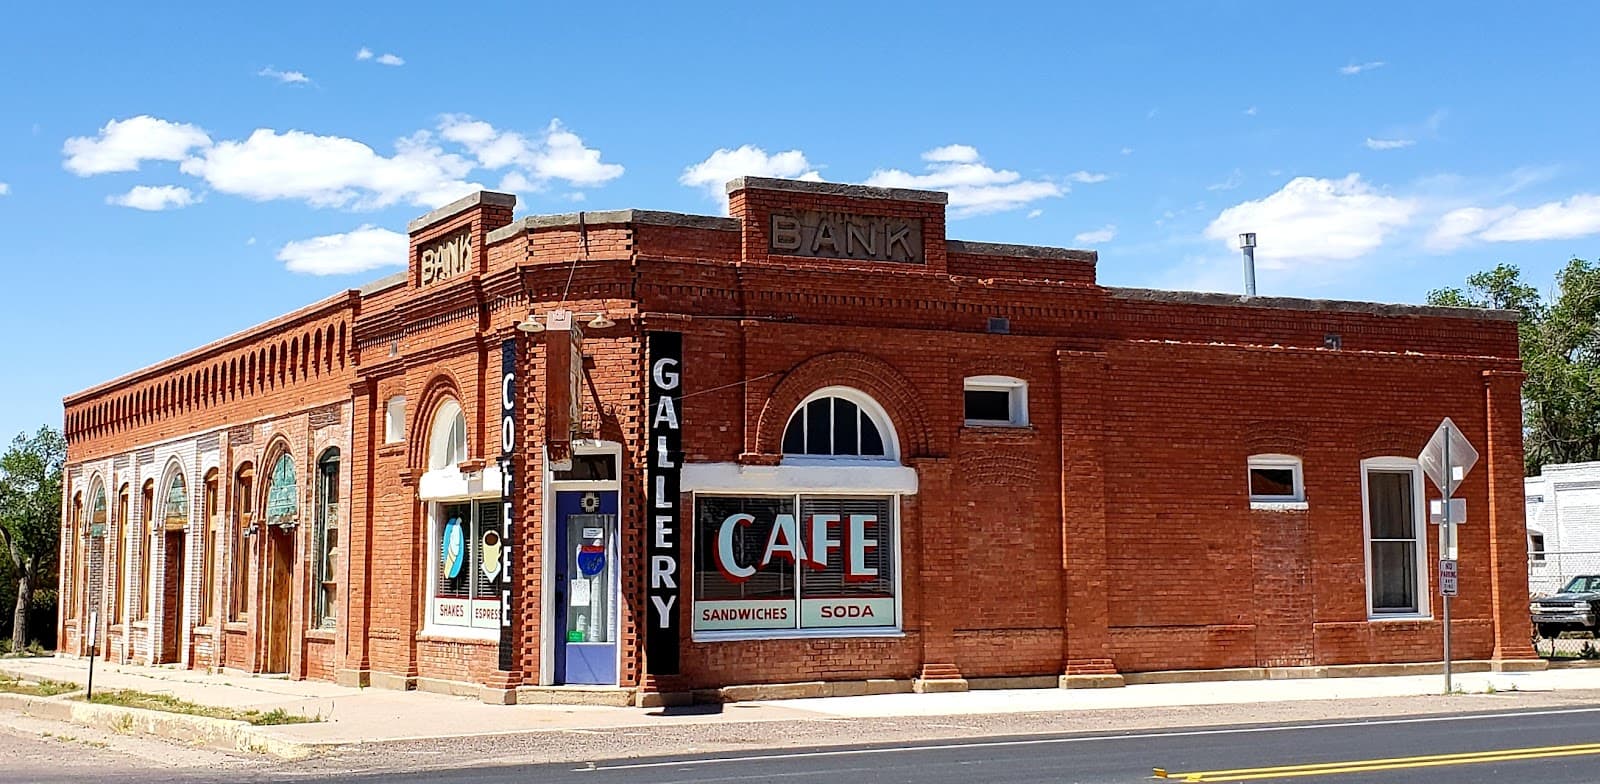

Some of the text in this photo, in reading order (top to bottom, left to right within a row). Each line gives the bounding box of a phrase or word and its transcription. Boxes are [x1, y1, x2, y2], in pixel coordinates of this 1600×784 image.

[422, 233, 472, 287] BANK
[772, 214, 914, 258] BANK
[502, 373, 514, 626] COFFEE
[651, 357, 680, 628] GALLERY
[713, 513, 879, 582] CAFE
[440, 604, 464, 617] SHAKES
[702, 607, 787, 621] SANDWICHES
[821, 605, 874, 618] SODA
